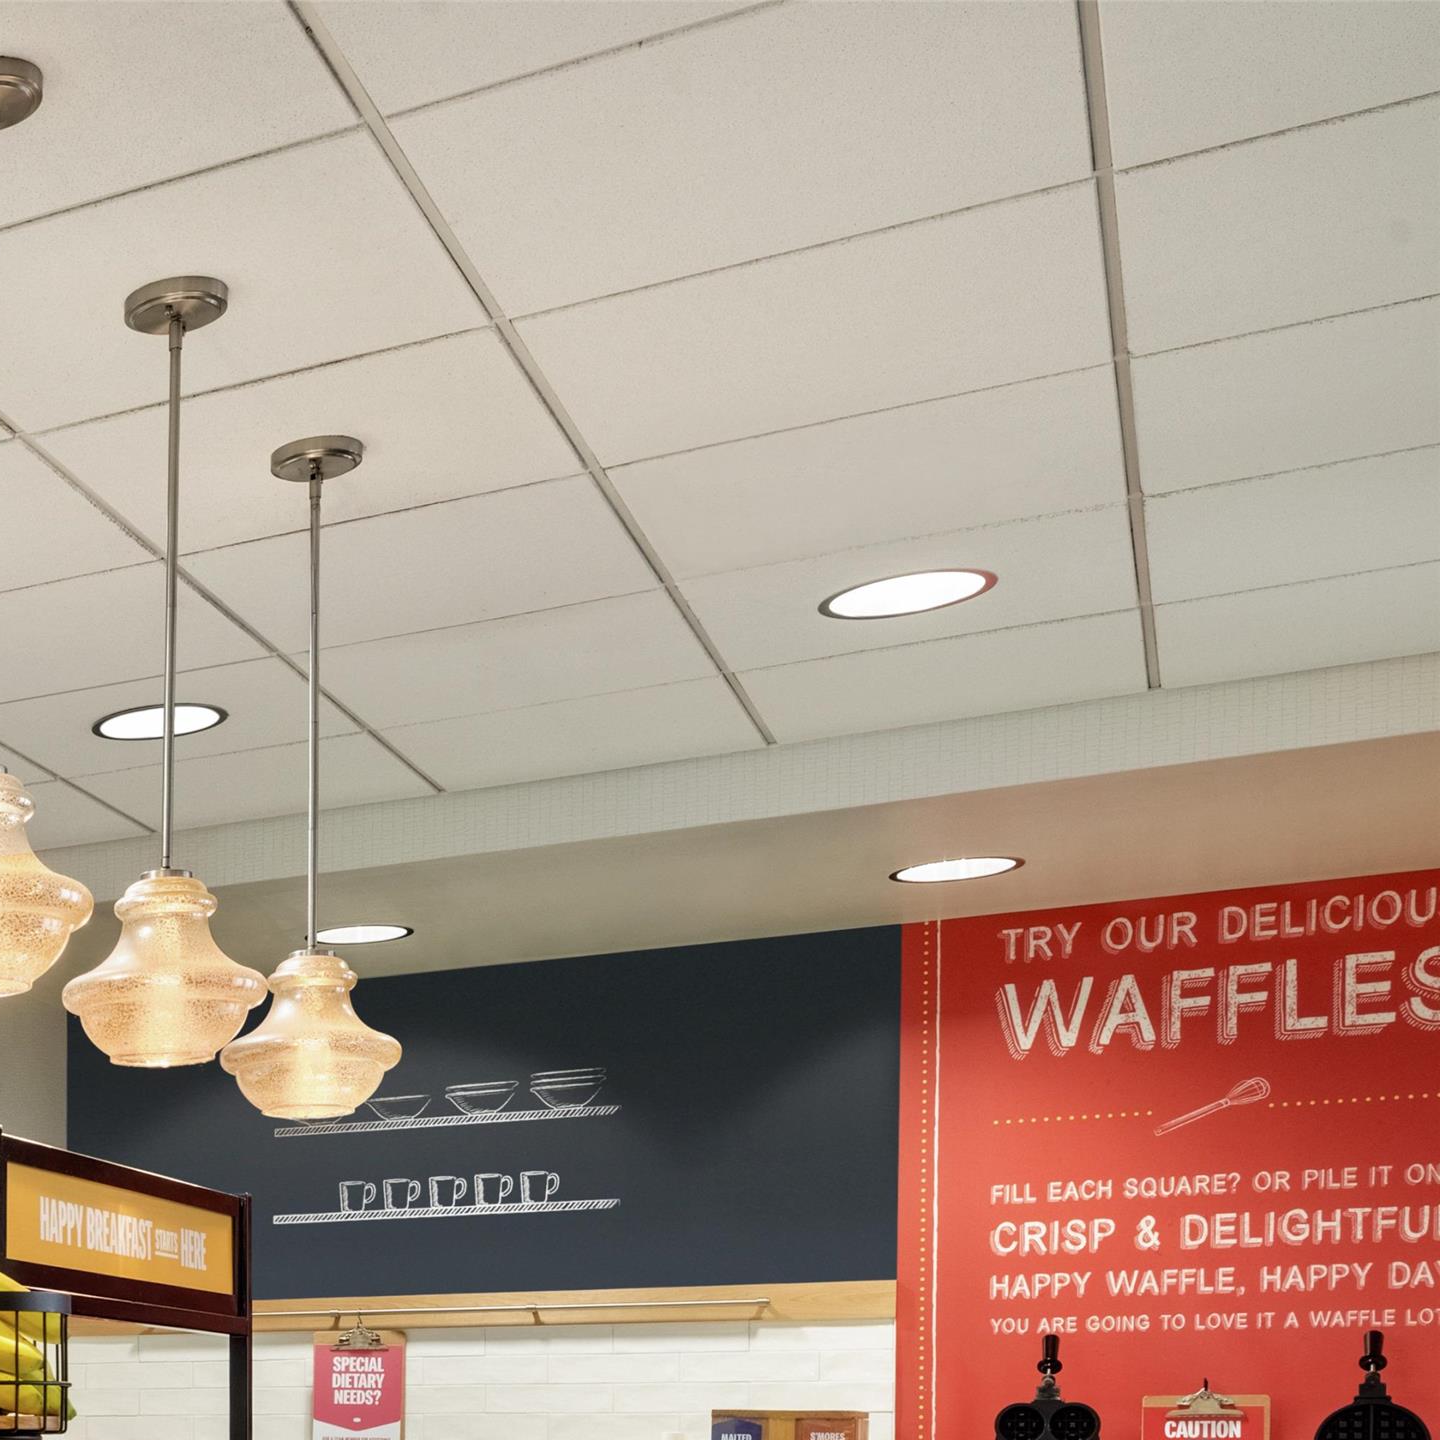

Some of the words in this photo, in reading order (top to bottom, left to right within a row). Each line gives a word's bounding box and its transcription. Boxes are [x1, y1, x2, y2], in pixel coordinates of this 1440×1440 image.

[997, 921, 1082, 964] TRY
[1101, 911, 1198, 954] OUR
[1218, 887, 1440, 944] DELICIOU
[991, 1183, 1037, 1205] FILL
[1047, 1179, 1113, 1202] EACH
[1123, 1172, 1241, 1198] SQUARE?
[1252, 1170, 1291, 1193] OR
[1302, 1167, 1358, 1191] PILE
[1370, 1165, 1393, 1187] IT
[40, 1196, 84, 1248] HAPPY
[86, 1206, 153, 1261] BREAKFAST
[155, 1229, 178, 1253] STARTS
[180, 1228, 207, 1271] HERE
[989, 1218, 1115, 1256] CRISP
[1134, 1214, 1161, 1251] &
[989, 1271, 1092, 1300] HAPPY
[1105, 1266, 1245, 1297] WAFFLE,
[1260, 1262, 1373, 1292] HAPPY
[990, 1317, 1029, 1335] YOU
[1036, 1316, 1078, 1334] ARE
[1085, 1314, 1150, 1333] GOING
[1159, 1313, 1186, 1331] TO
[1194, 1312, 1248, 1330] LOVE
[1256, 1311, 1275, 1329] IT
[1284, 1311, 1299, 1329] A
[1309, 1309, 1396, 1328] WAFFLE
[333, 1356, 384, 1372] SPECIAL
[332, 1373, 385, 1389] DIETARY
[333, 1389, 381, 1405] NEEDS?
[1164, 1420, 1241, 1439] CAUTION
